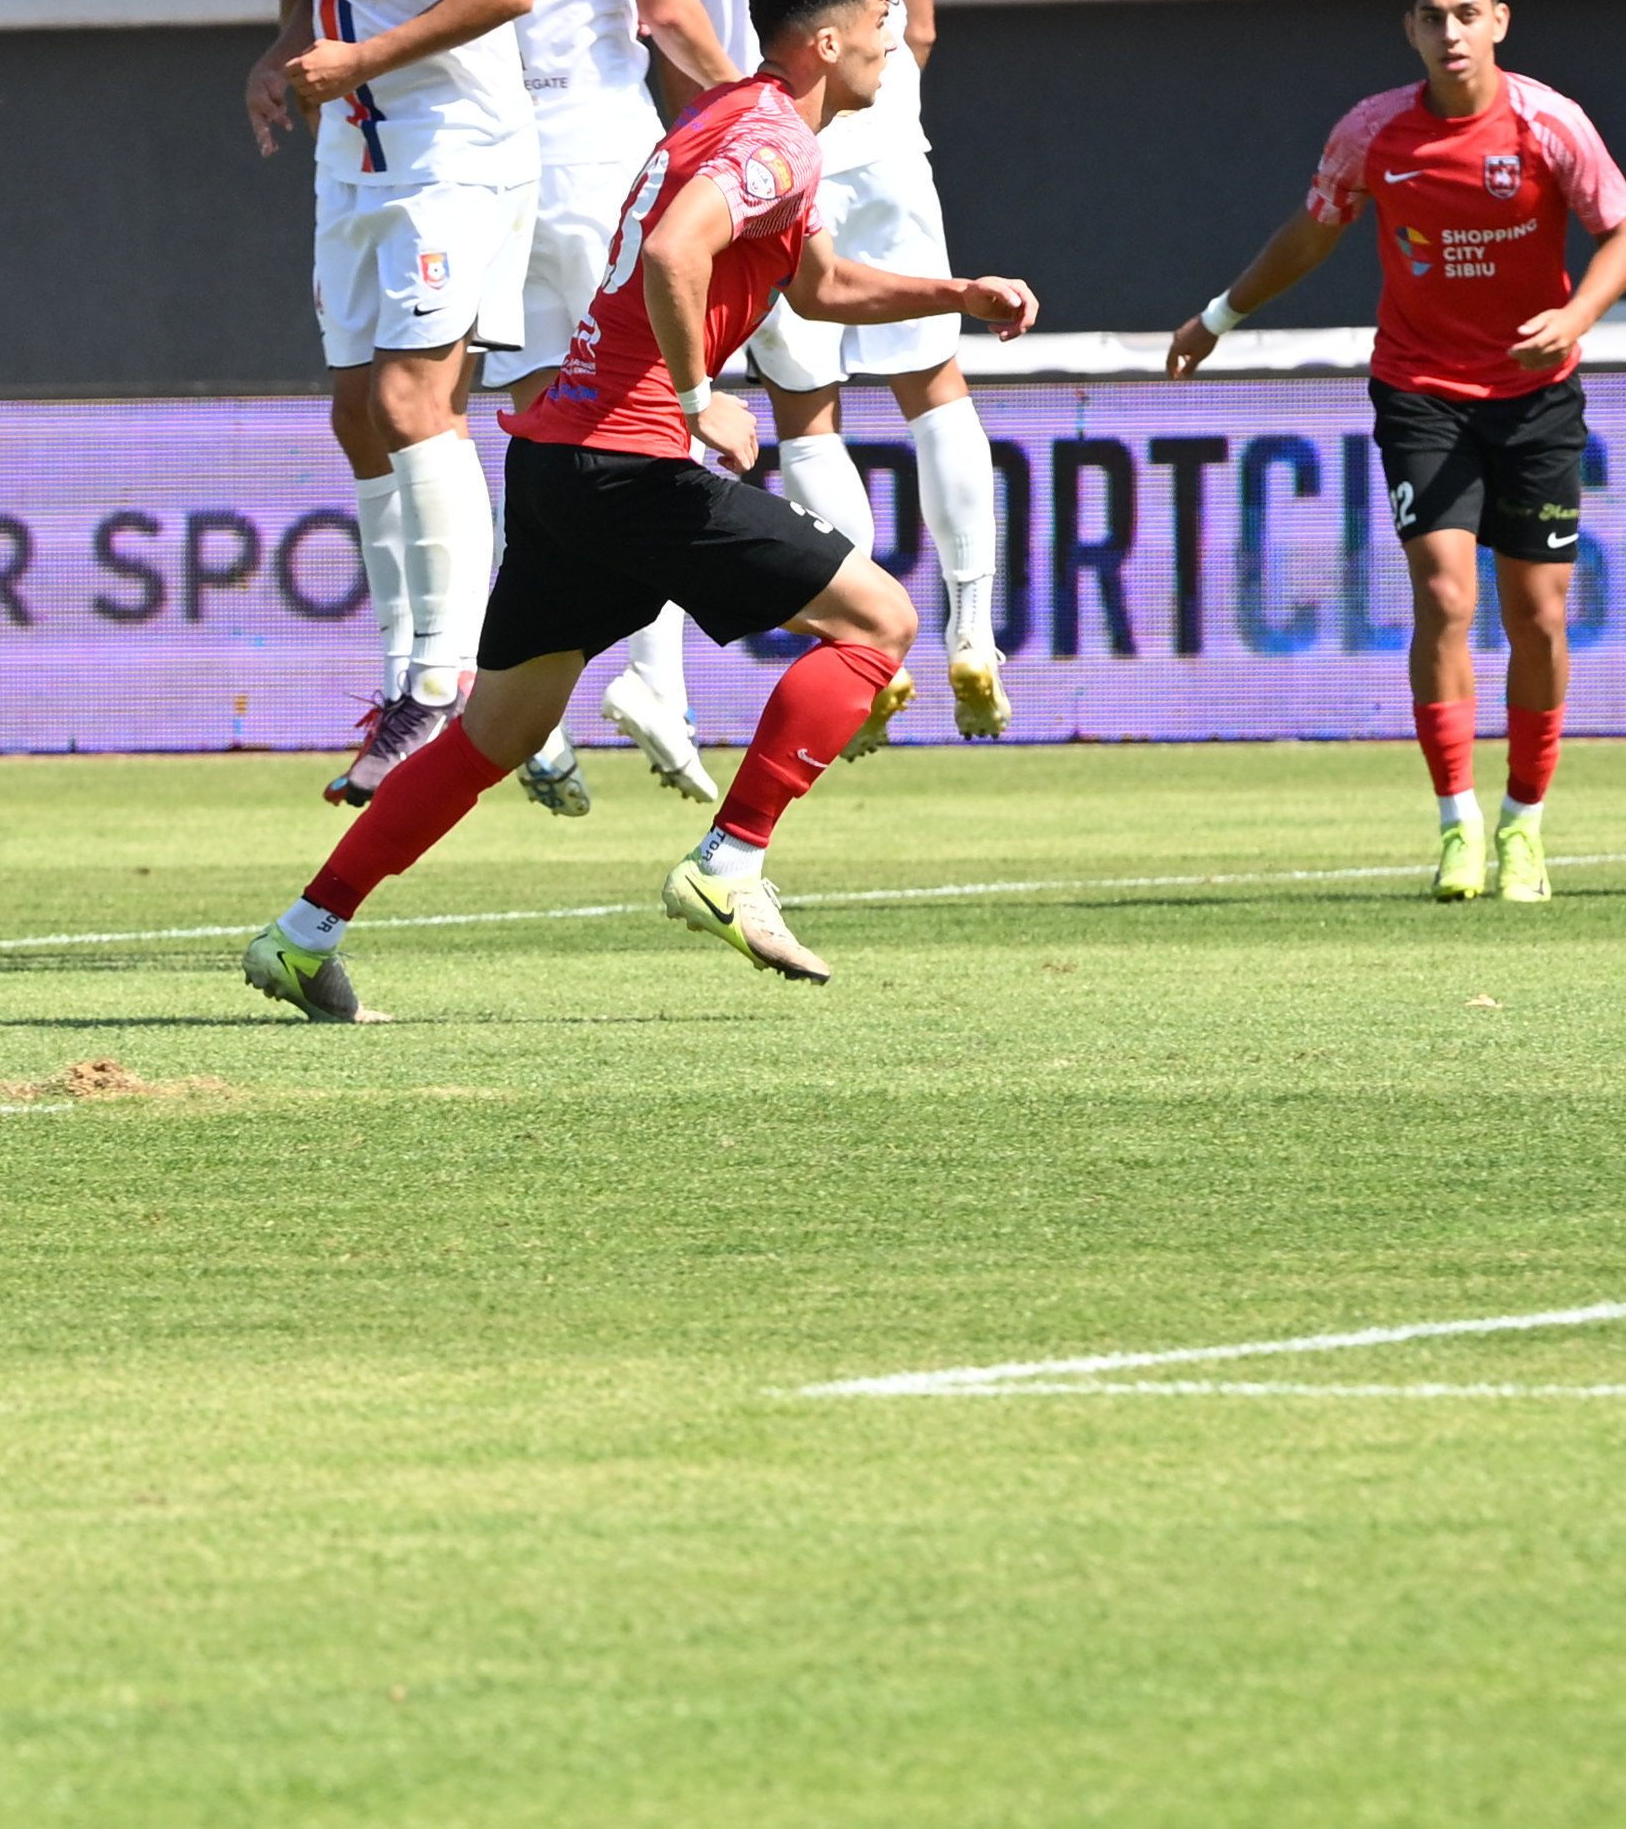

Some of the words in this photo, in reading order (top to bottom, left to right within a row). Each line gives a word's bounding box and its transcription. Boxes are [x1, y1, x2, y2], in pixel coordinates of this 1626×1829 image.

[1441, 218, 1538, 244] SHOPPING
[1443, 246, 1486, 261] CITY
[1444, 262, 1496, 278] SIBIU
[701, 831, 727, 862] TOR
